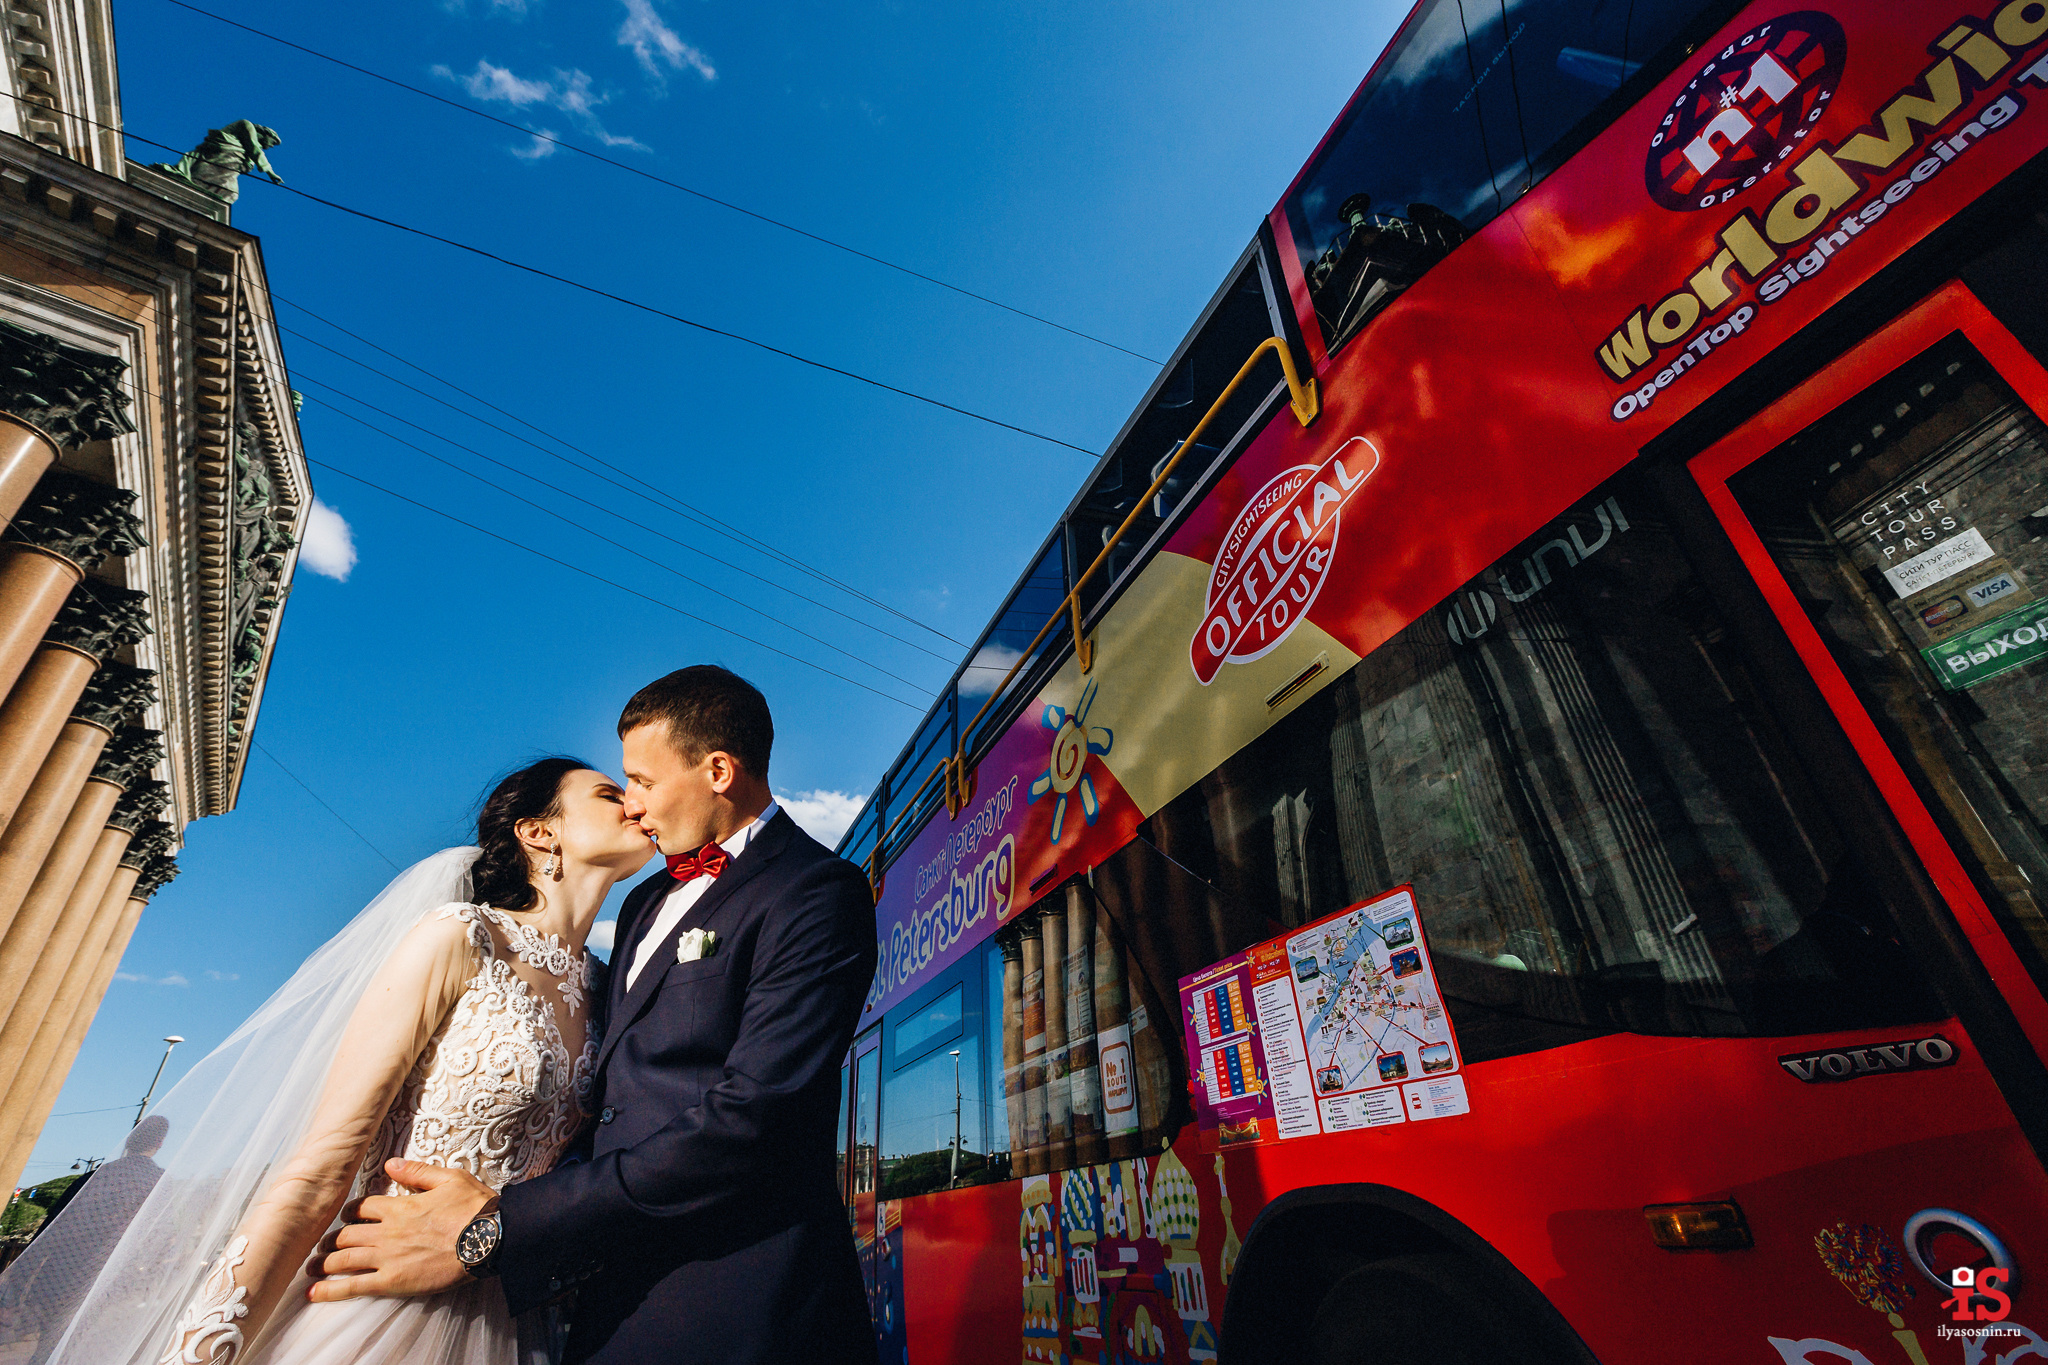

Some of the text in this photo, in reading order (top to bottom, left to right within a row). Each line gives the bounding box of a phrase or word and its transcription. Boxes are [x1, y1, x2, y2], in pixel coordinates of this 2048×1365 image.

[1759, 95, 2019, 301] Sightseeing
[1861, 481, 1931, 526] CITY
[1870, 499, 1944, 543] TOUR
[1216, 473, 1302, 587] CITYSIGHTSEEING
[1883, 516, 1957, 560] PASS
[1206, 460, 1364, 657] OFFICIAL
[1899, 540, 1972, 579] СИТИ ТУР ПАСС
[1256, 546, 1329, 640] TOUR
[1972, 579, 2011, 599] VISA
[915, 775, 1018, 903] Санкт-Петербург
[889, 834, 1014, 992] Petersburg
[1107, 1074, 1127, 1088] ROUTE
[1781, 1038, 1953, 1080] VOLVO
